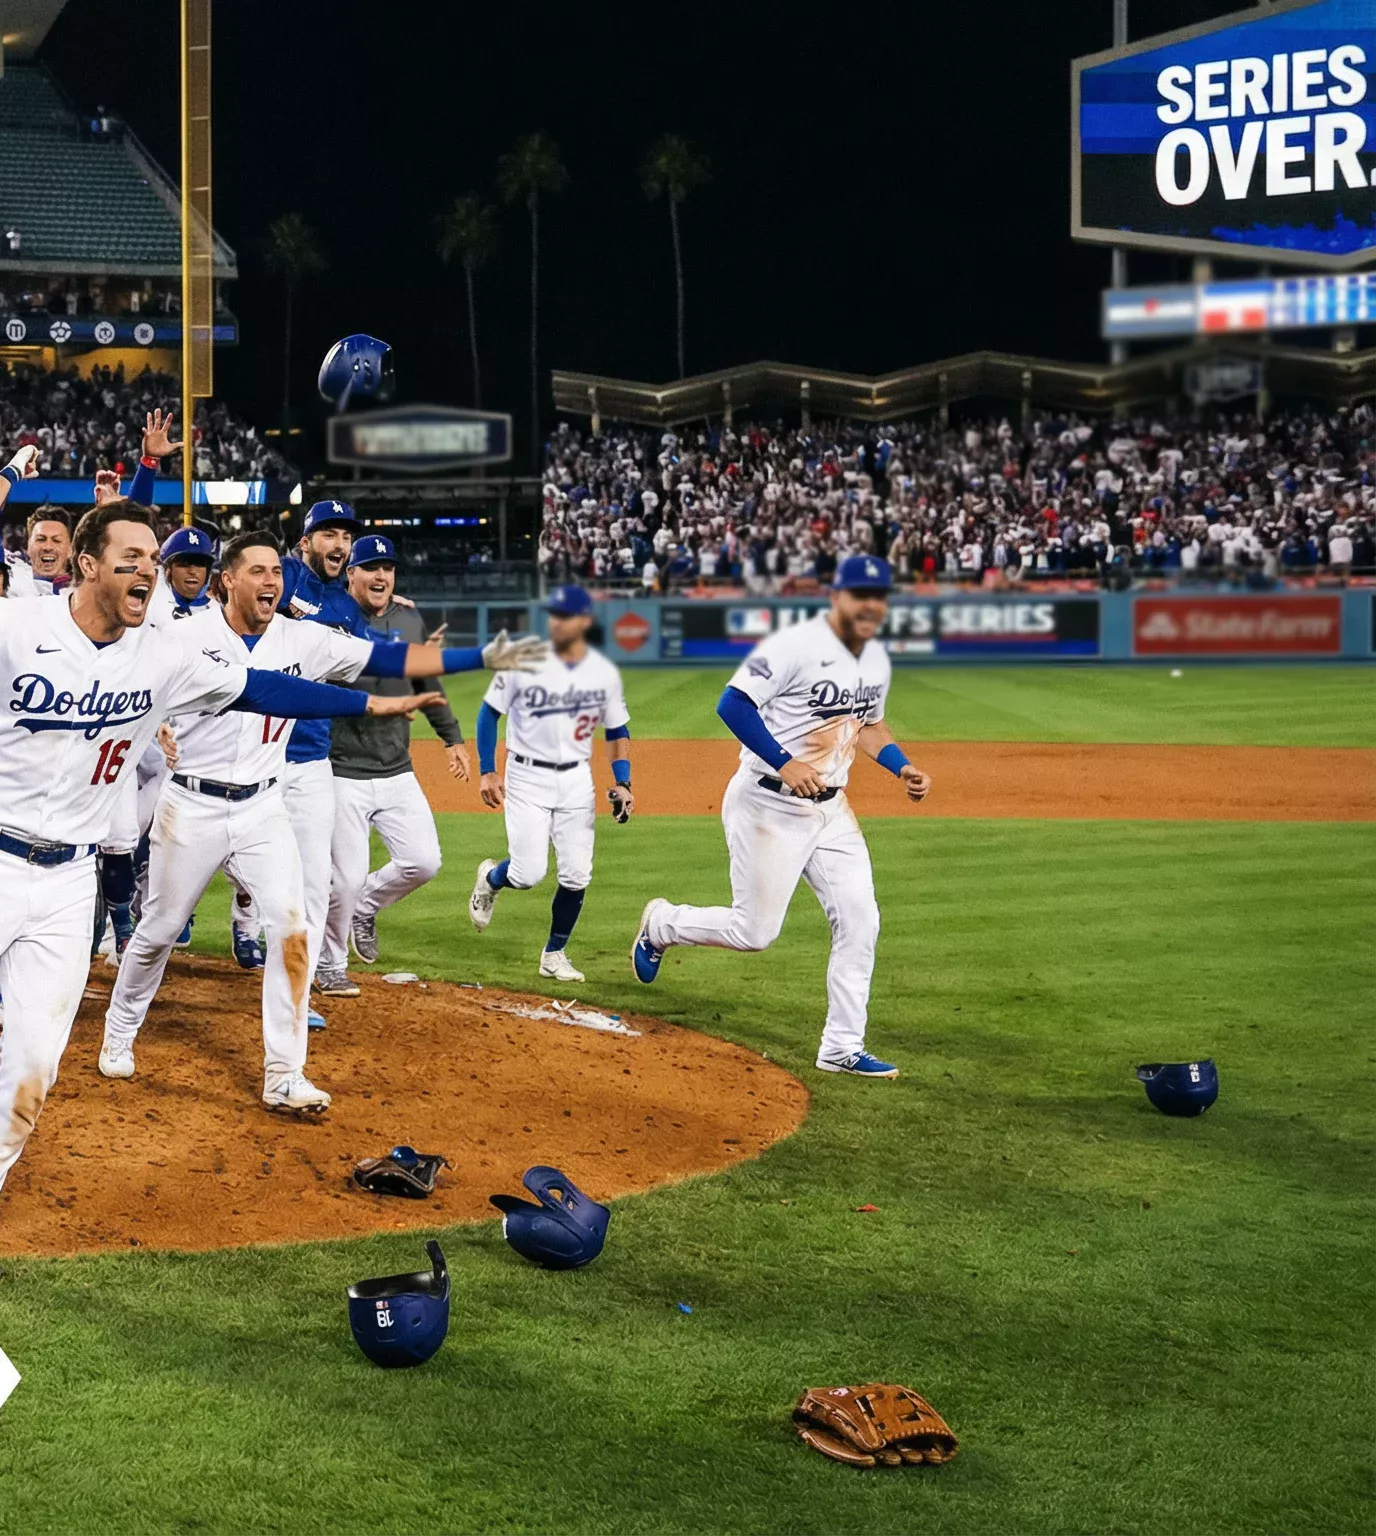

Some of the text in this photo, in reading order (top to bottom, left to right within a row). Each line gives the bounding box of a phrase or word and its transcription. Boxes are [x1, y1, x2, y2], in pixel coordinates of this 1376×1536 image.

[1156, 45, 1367, 124] SERIES
[940, 603, 1055, 634] SERIES
[9, 673, 153, 741] Dodgers
[524, 684, 606, 718] Dodgers
[90, 738, 132, 785] 16
